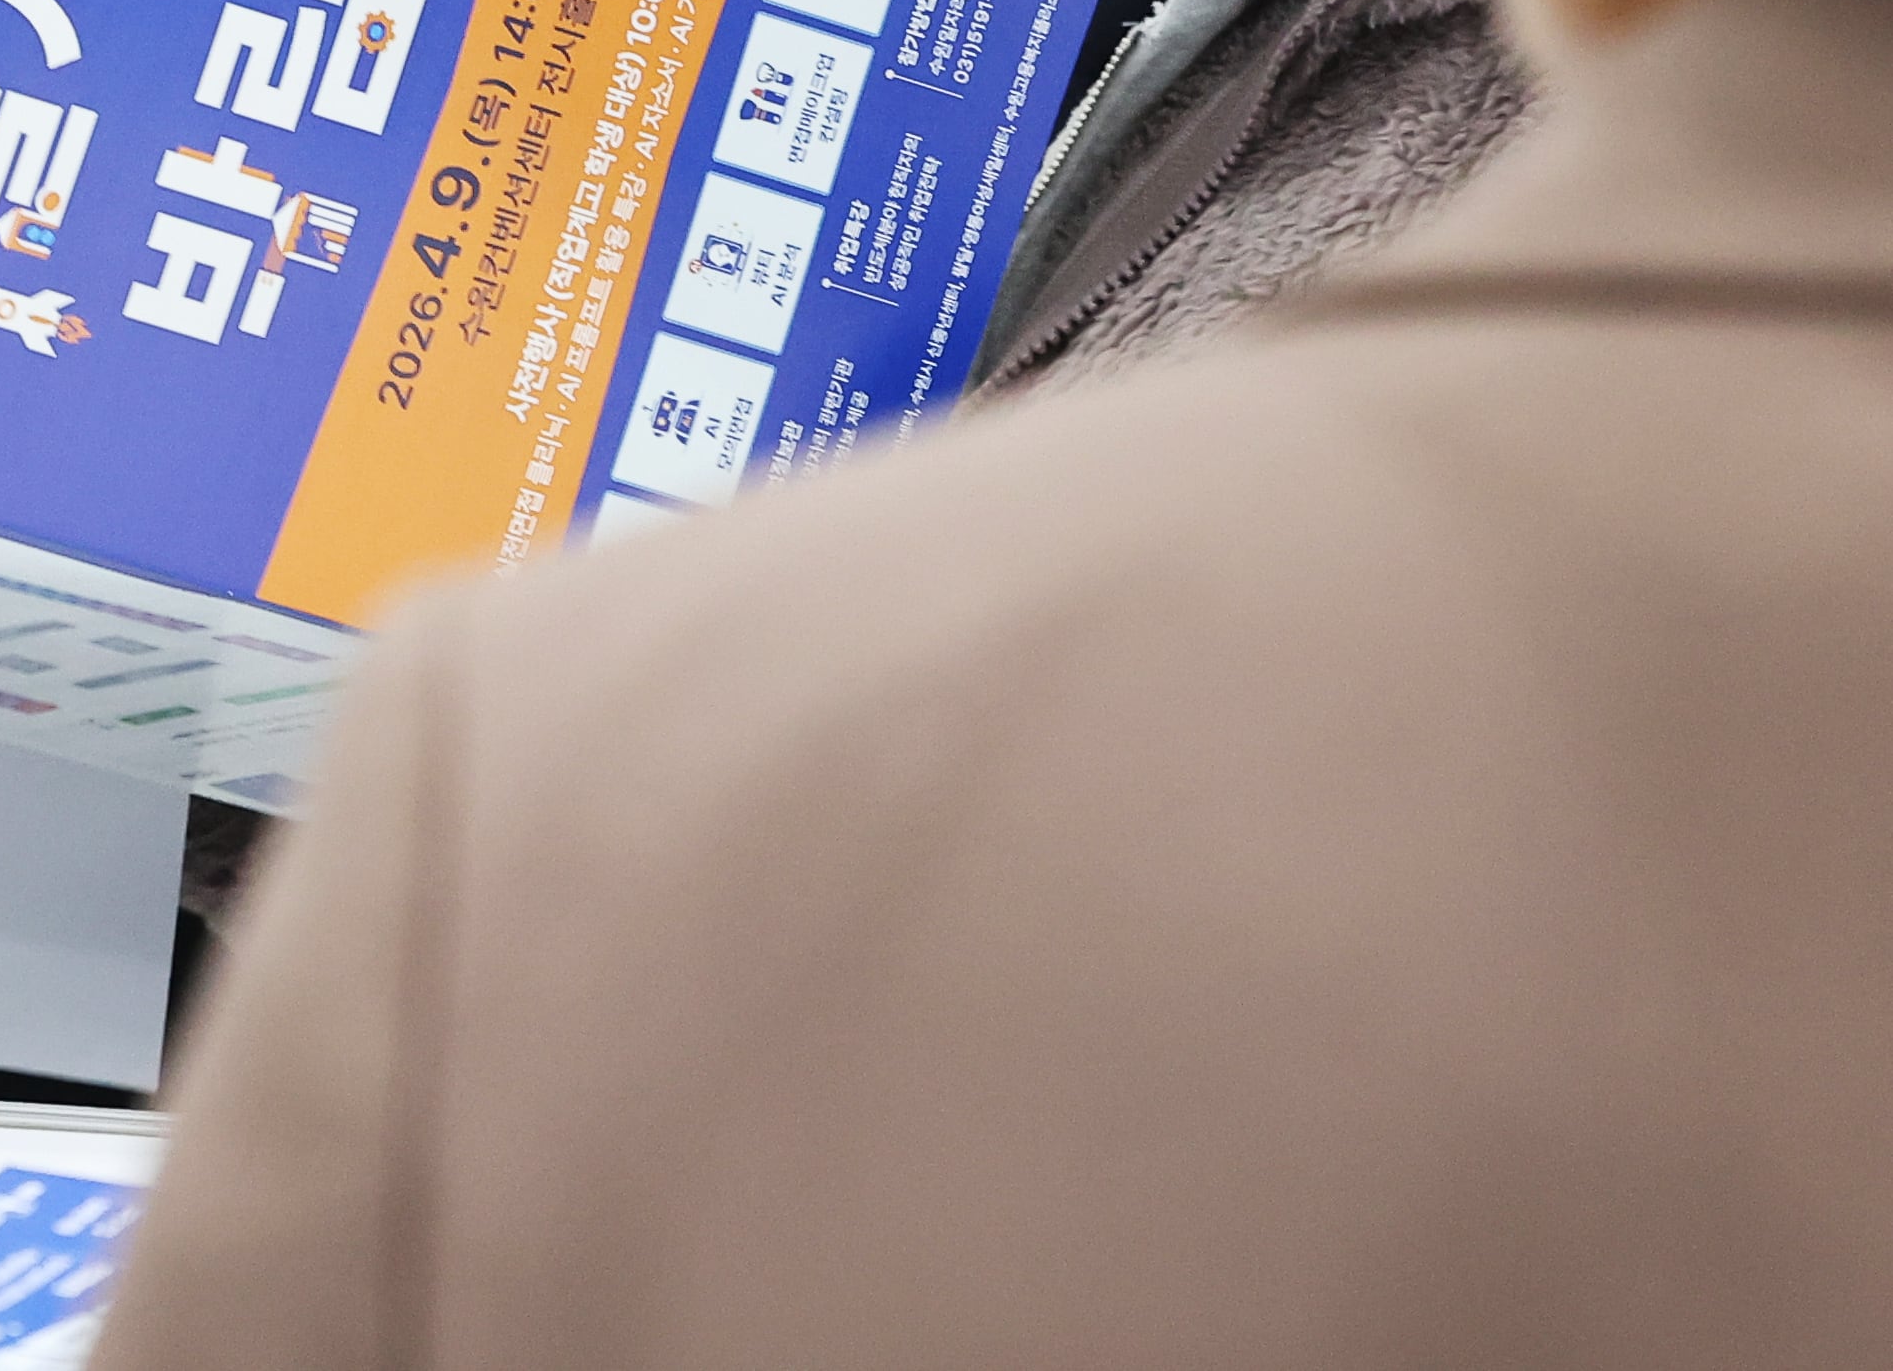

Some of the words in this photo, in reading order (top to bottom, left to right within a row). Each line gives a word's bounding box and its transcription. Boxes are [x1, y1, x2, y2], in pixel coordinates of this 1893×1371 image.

[663, 11, 699, 48] AI
[595, 46, 652, 124] 대상)
[634, 51, 689, 134] 자소서
[787, 53, 836, 163] 면접메이크업
[819, 87, 849, 143] 컨설팅
[577, 115, 631, 185] 학생
[629, 128, 663, 165] AI
[458, 102, 563, 346] 수원컨벤션센터
[605, 168, 651, 228] 특강
[856, 196, 907, 287] 반도체분야
[882, 129, 927, 203] 현직자의
[901, 152, 948, 227] 취업전략
[378, 77, 517, 411] 2026.4.9.(목)
[538, 174, 614, 307] (직업계고
[590, 218, 637, 280] 활용
[750, 249, 776, 285] 뷰티
[776, 243, 802, 281] 분석
[826, 195, 878, 279] 취업특강
[881, 220, 927, 295] 성공적인
[557, 269, 621, 377] 프롬프트
[770, 284, 788, 307] AI
[496, 296, 573, 428] 사전행사
[550, 369, 586, 405] AI
[813, 353, 859, 431] 관련기관
[904, 355, 941, 409] 수원시
[704, 416, 722, 439] AI
[716, 397, 754, 470] 모의면접
[767, 415, 808, 470] 정보관
[840, 385, 874, 430] 제공
[519, 408, 575, 492] 클리닉
